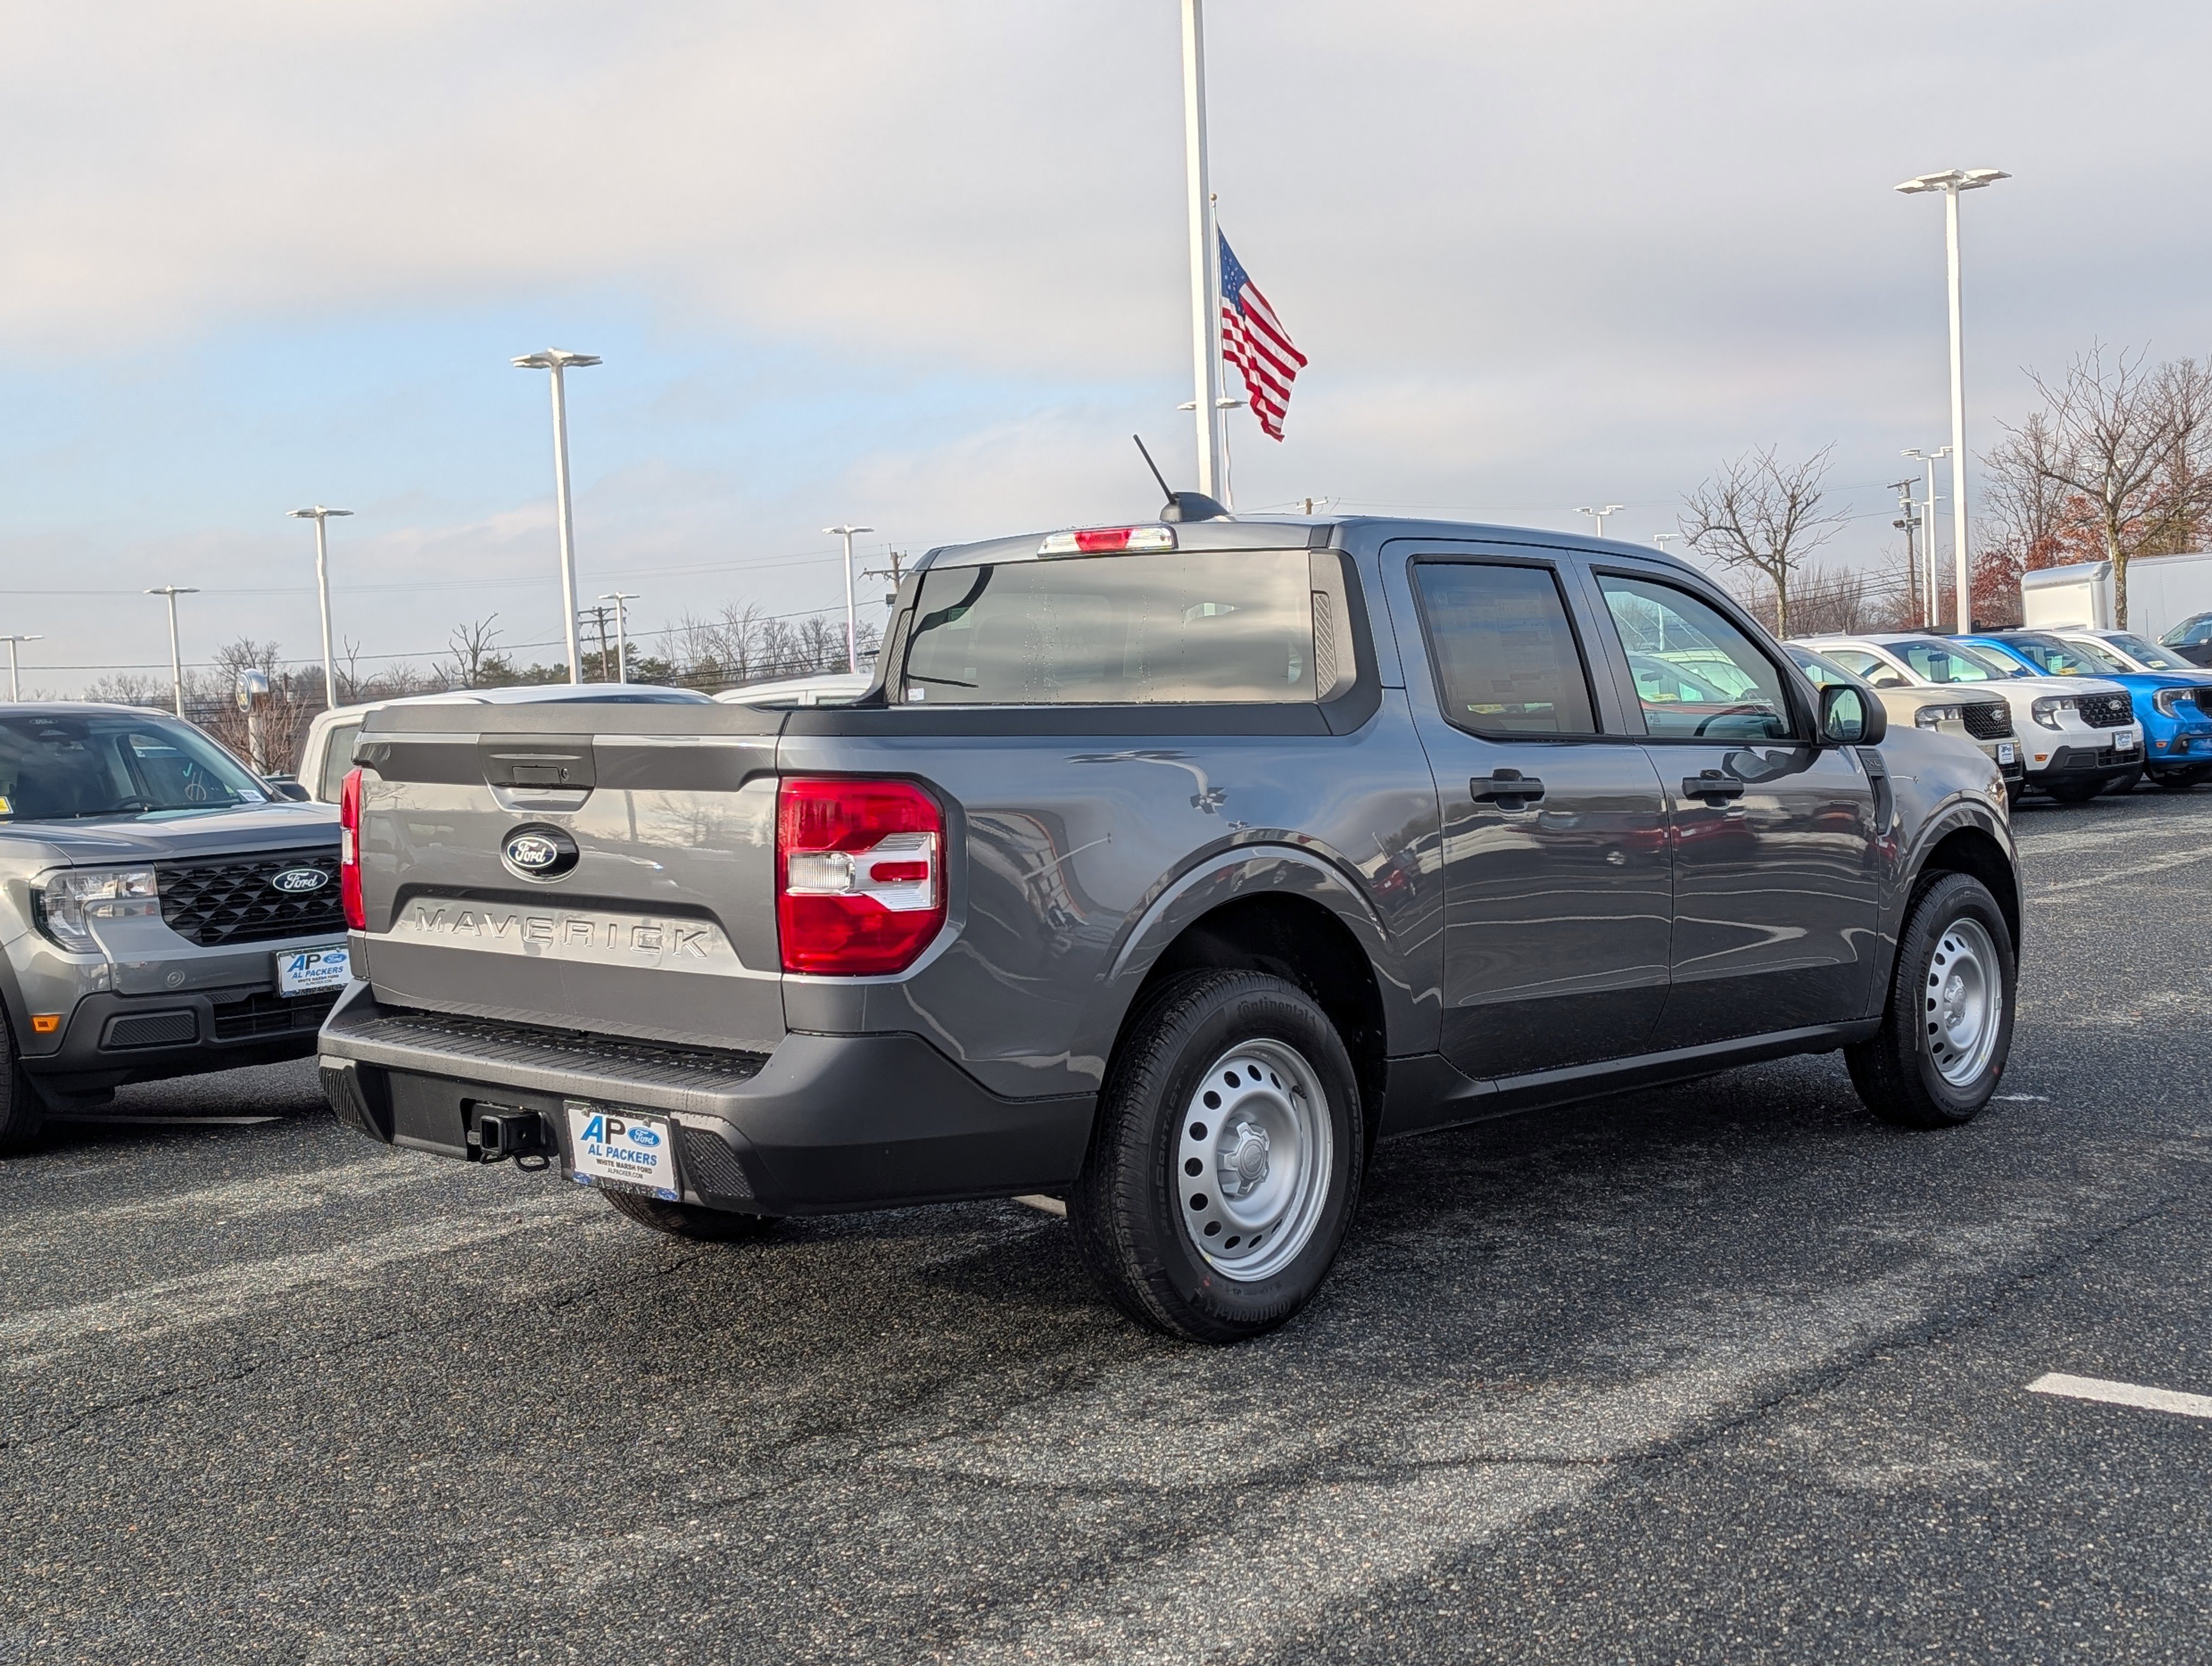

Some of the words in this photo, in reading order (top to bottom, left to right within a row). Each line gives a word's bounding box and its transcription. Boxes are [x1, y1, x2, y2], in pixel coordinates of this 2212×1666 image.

[515, 840, 547, 863] Ford
[284, 872, 318, 889] Ford
[414, 906, 707, 958] MAVERICK
[287, 954, 321, 972] AP
[305, 966, 344, 977] PACKERS
[580, 1116, 626, 1144] AP
[588, 1144, 603, 1156] AL
[606, 1146, 658, 1167] PACKERS
[596, 1158, 615, 1167] WHITE
[616, 1161, 636, 1171] MARSH
[637, 1165, 653, 1174] FORD
